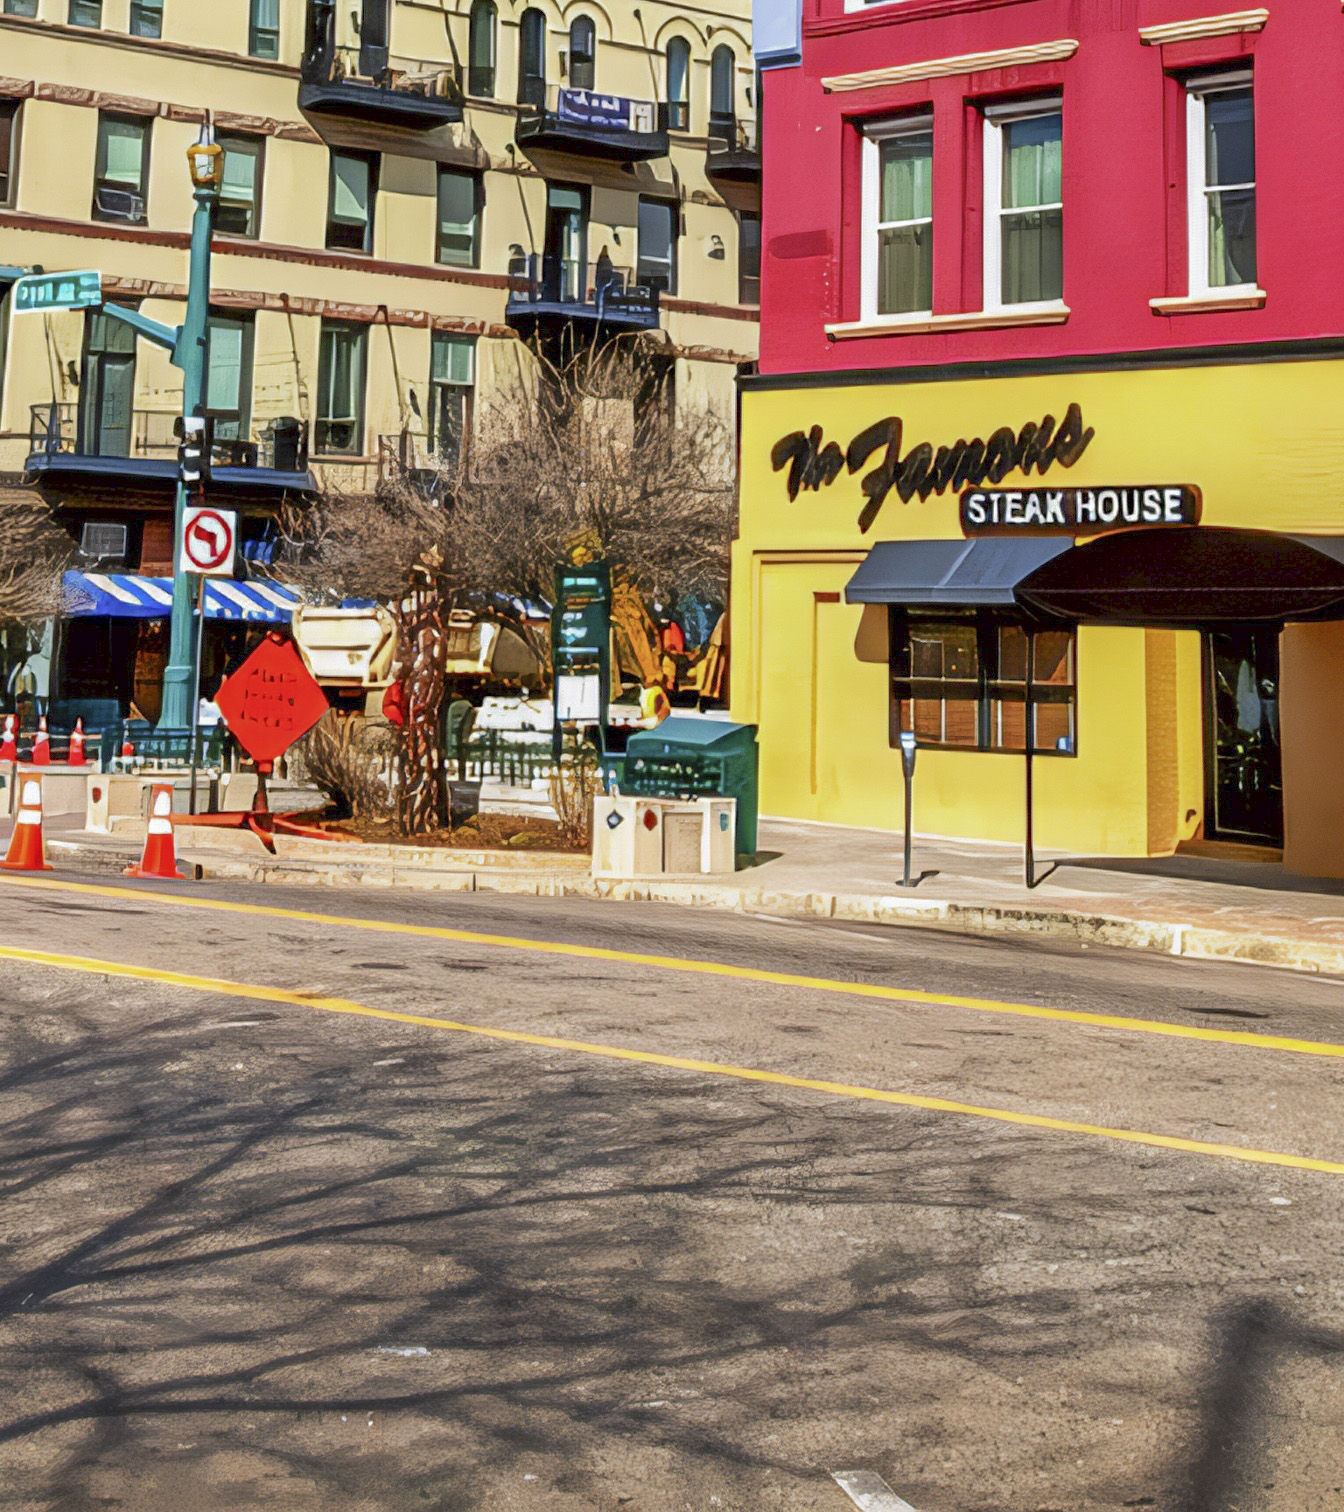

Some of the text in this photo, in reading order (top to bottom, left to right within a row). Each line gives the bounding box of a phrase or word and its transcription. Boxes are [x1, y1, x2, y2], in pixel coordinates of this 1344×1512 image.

[846, 402, 1096, 535] Famous
[967, 488, 1184, 525] STEAK HOUSE
